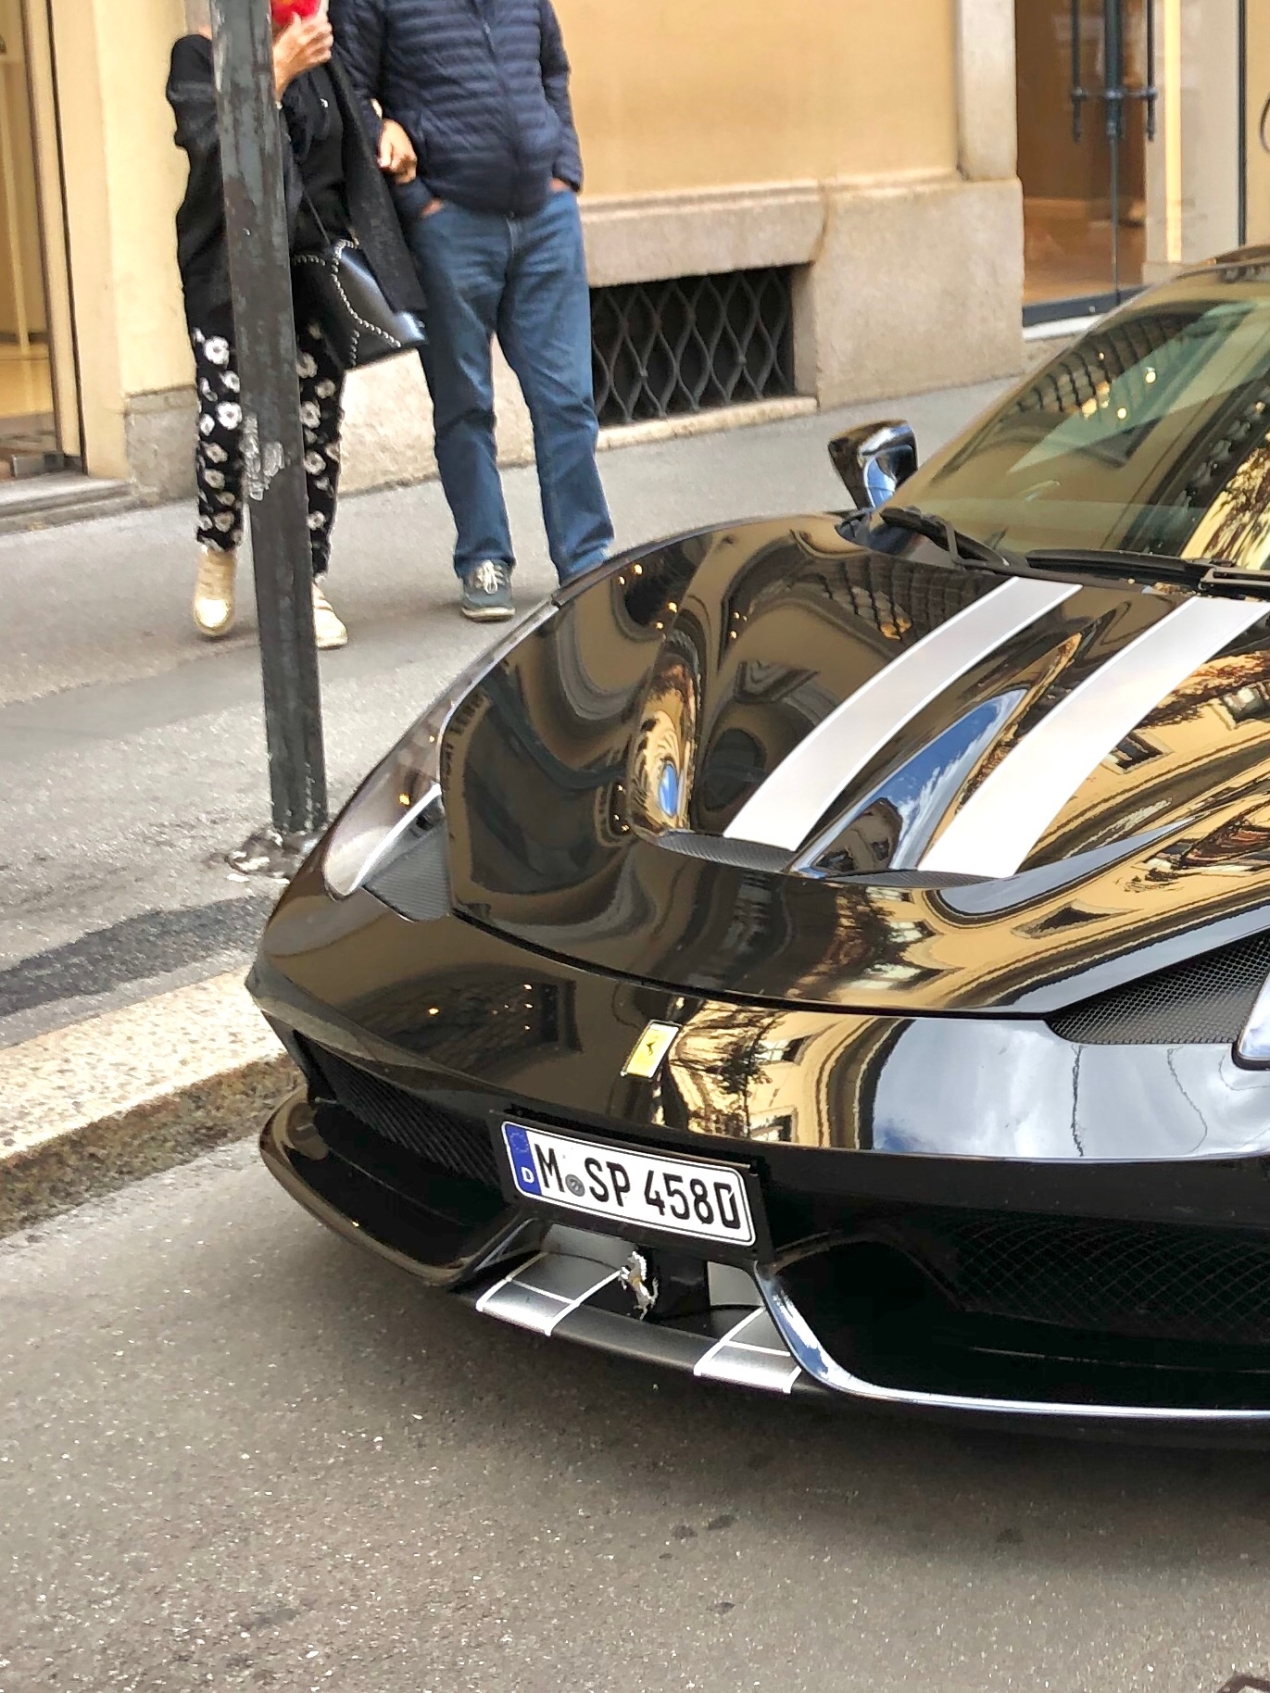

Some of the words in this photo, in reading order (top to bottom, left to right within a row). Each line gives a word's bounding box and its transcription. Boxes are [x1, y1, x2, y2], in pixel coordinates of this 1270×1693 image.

[520, 1166, 535, 1183] D
[534, 1144, 565, 1193] M
[584, 1157, 631, 1207] SP
